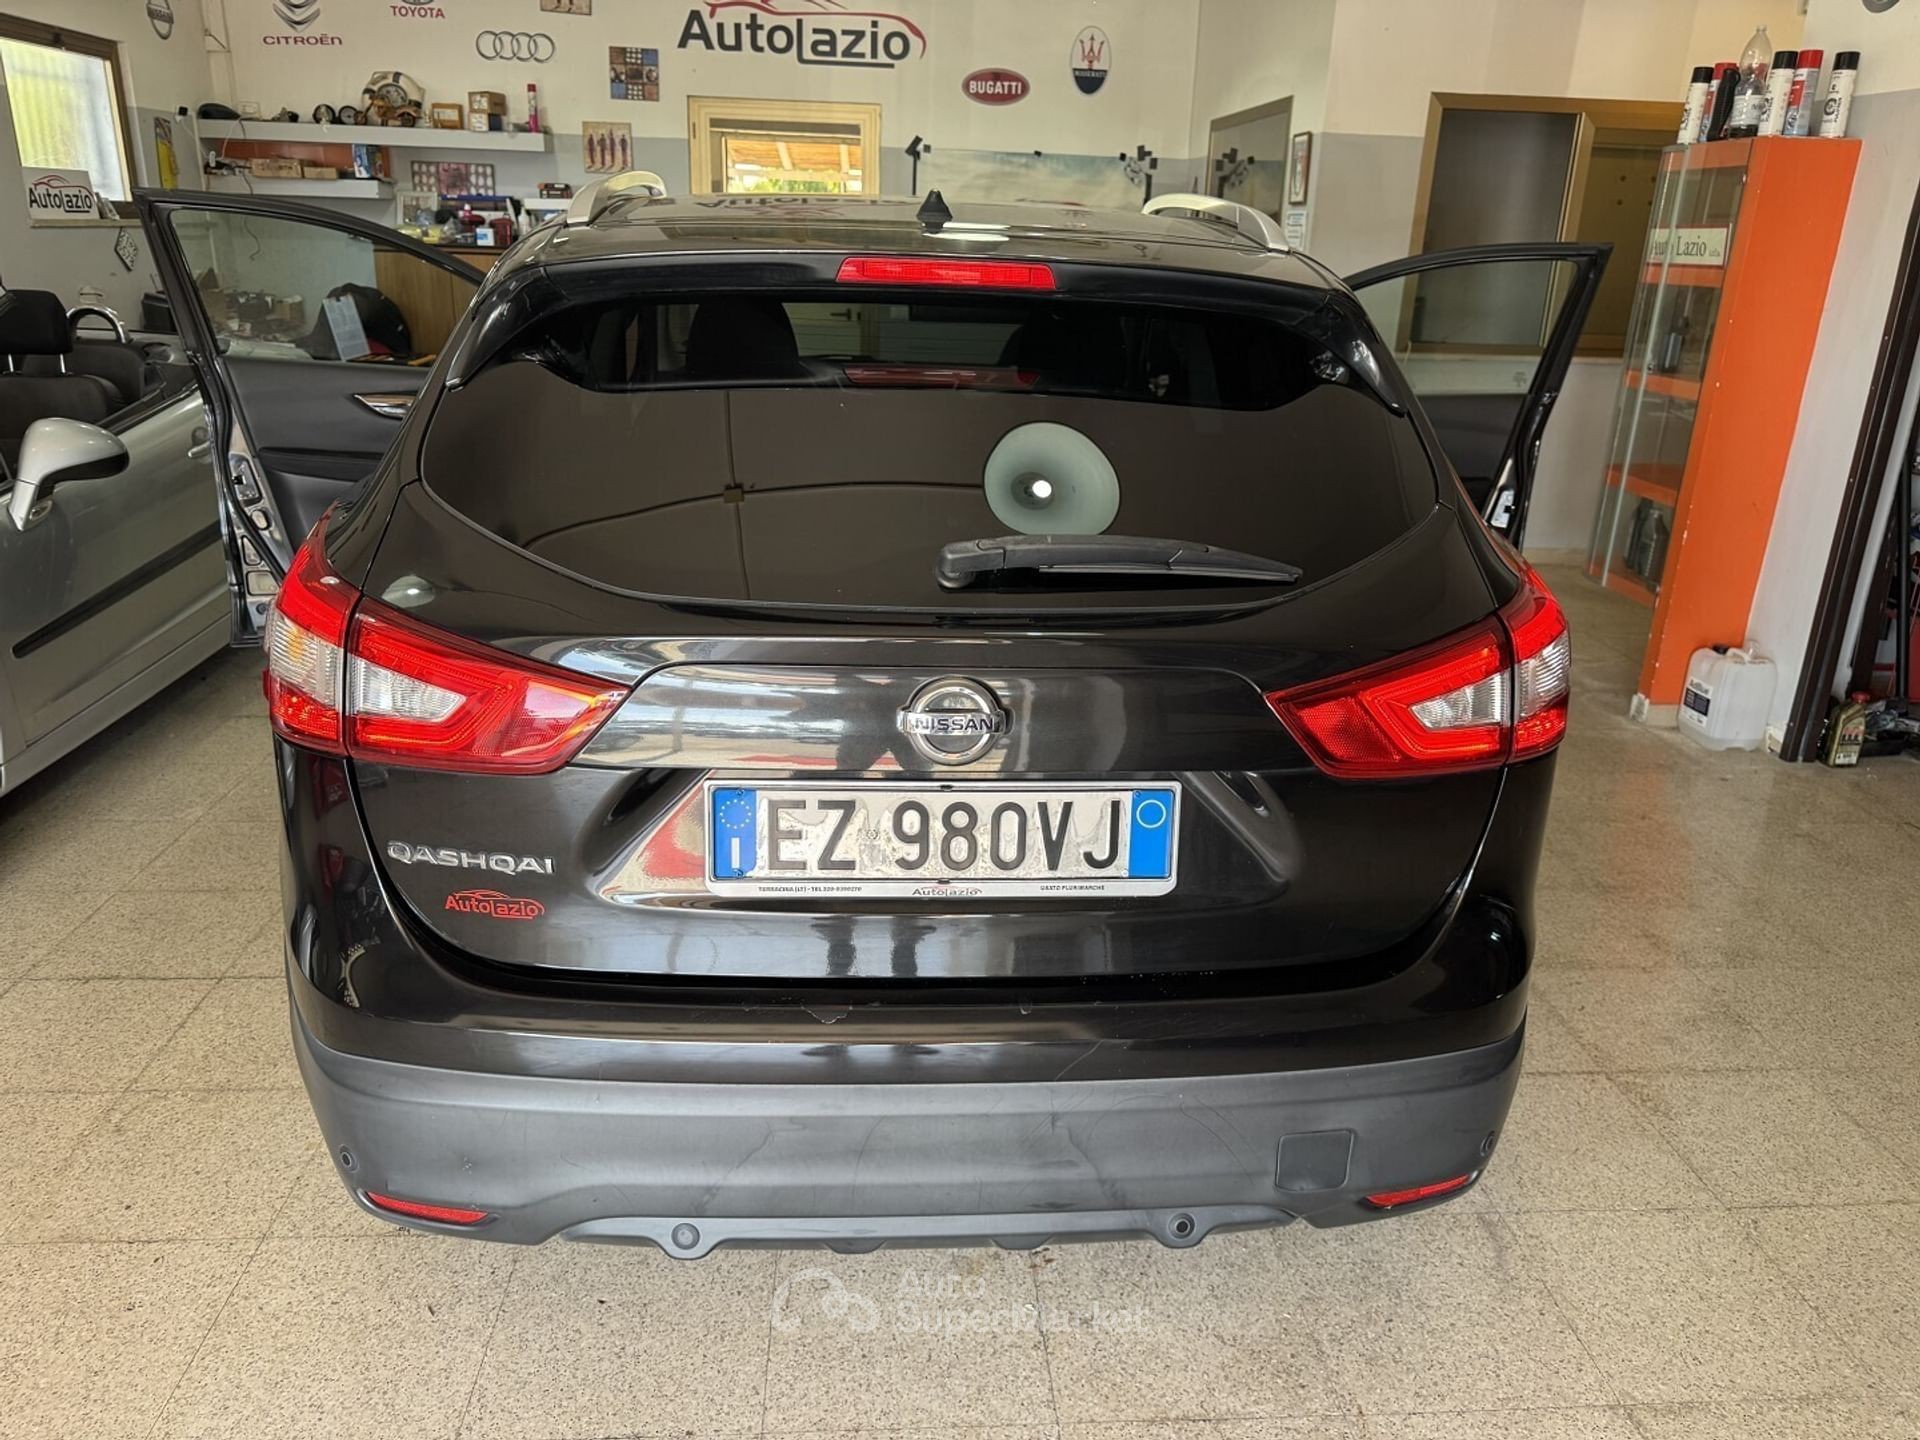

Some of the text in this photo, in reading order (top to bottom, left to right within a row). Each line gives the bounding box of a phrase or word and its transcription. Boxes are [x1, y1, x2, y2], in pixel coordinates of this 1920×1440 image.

[390, 5, 446, 19] TOYOTA
[969, 80, 1023, 95] BUGATTI
[1676, 235, 1708, 257] Lazio
[915, 717, 994, 732] NISSAN
[767, 799, 1121, 872] EZ 980VJ
[387, 840, 557, 876] QASHQAI
